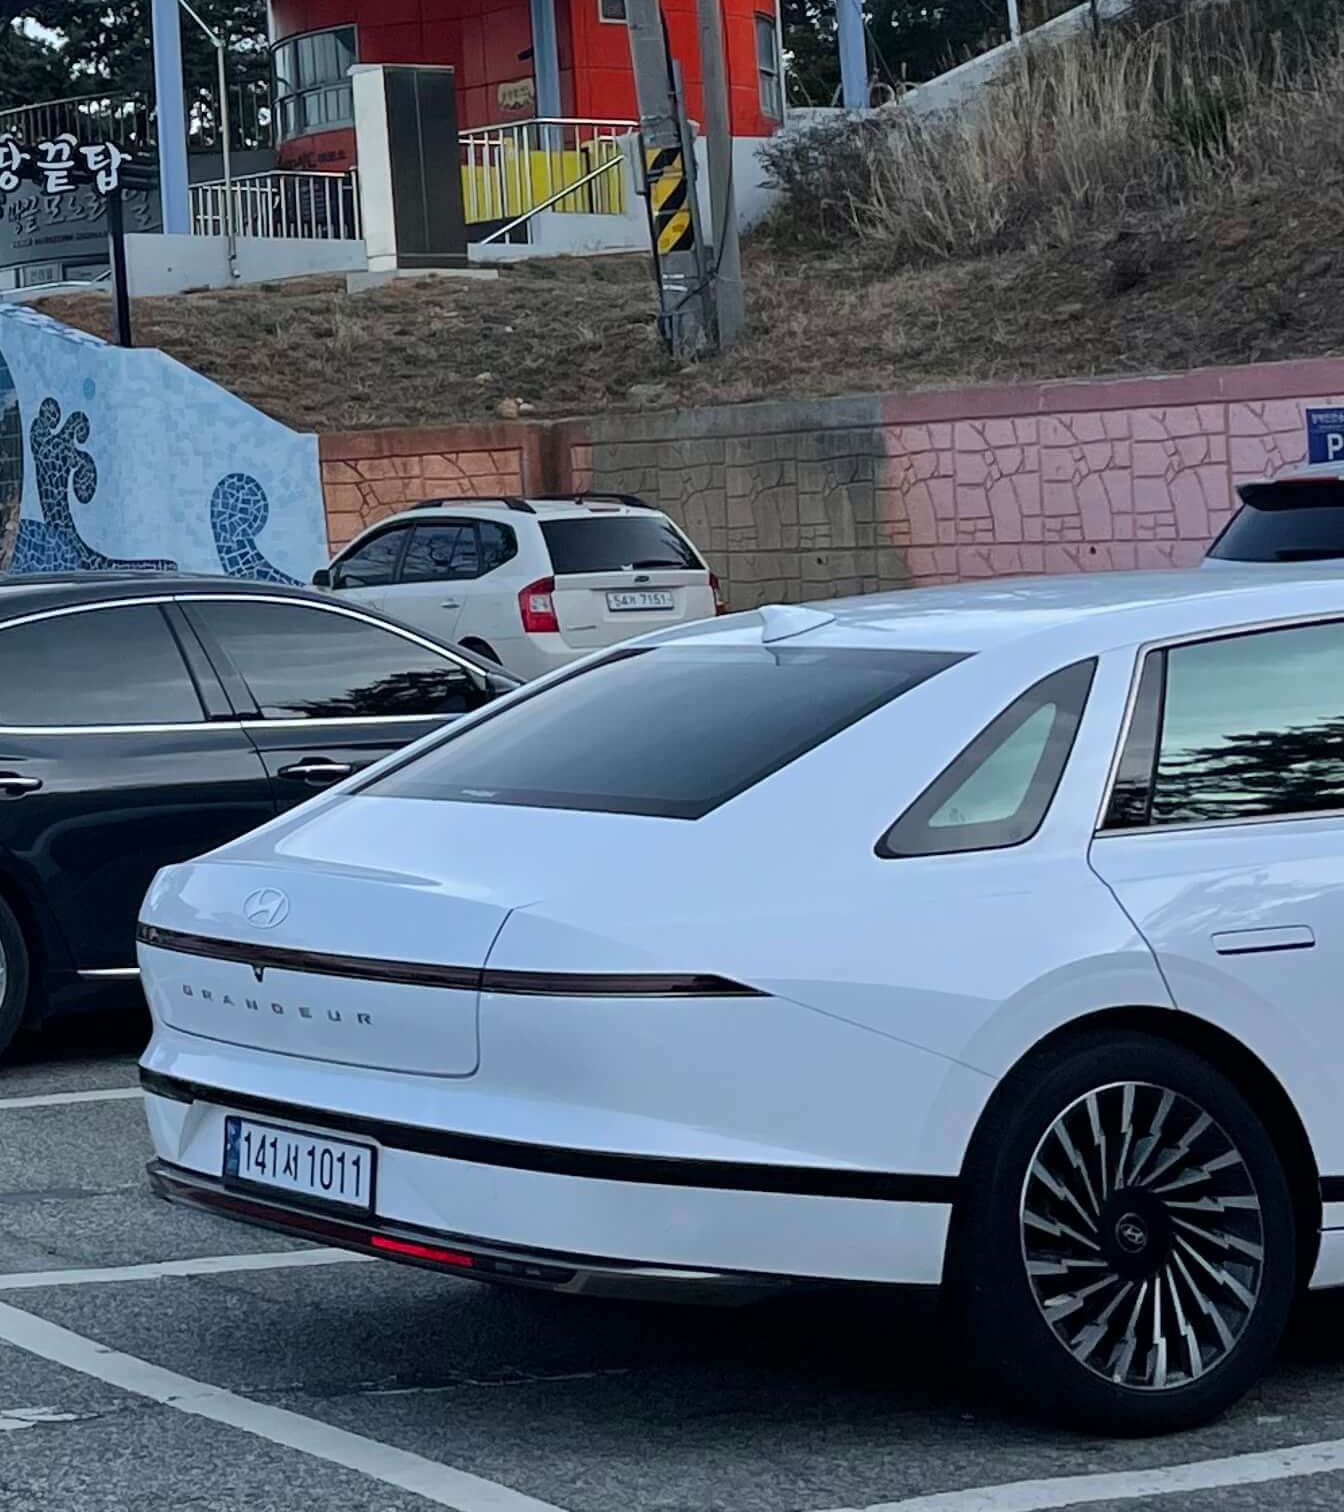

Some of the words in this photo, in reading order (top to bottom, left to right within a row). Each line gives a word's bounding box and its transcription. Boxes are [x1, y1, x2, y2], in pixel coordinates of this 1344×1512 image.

[182, 983, 372, 1025] GRANDEUR
[244, 1131, 298, 1181] 141서
[307, 1145, 361, 1197] 1011
